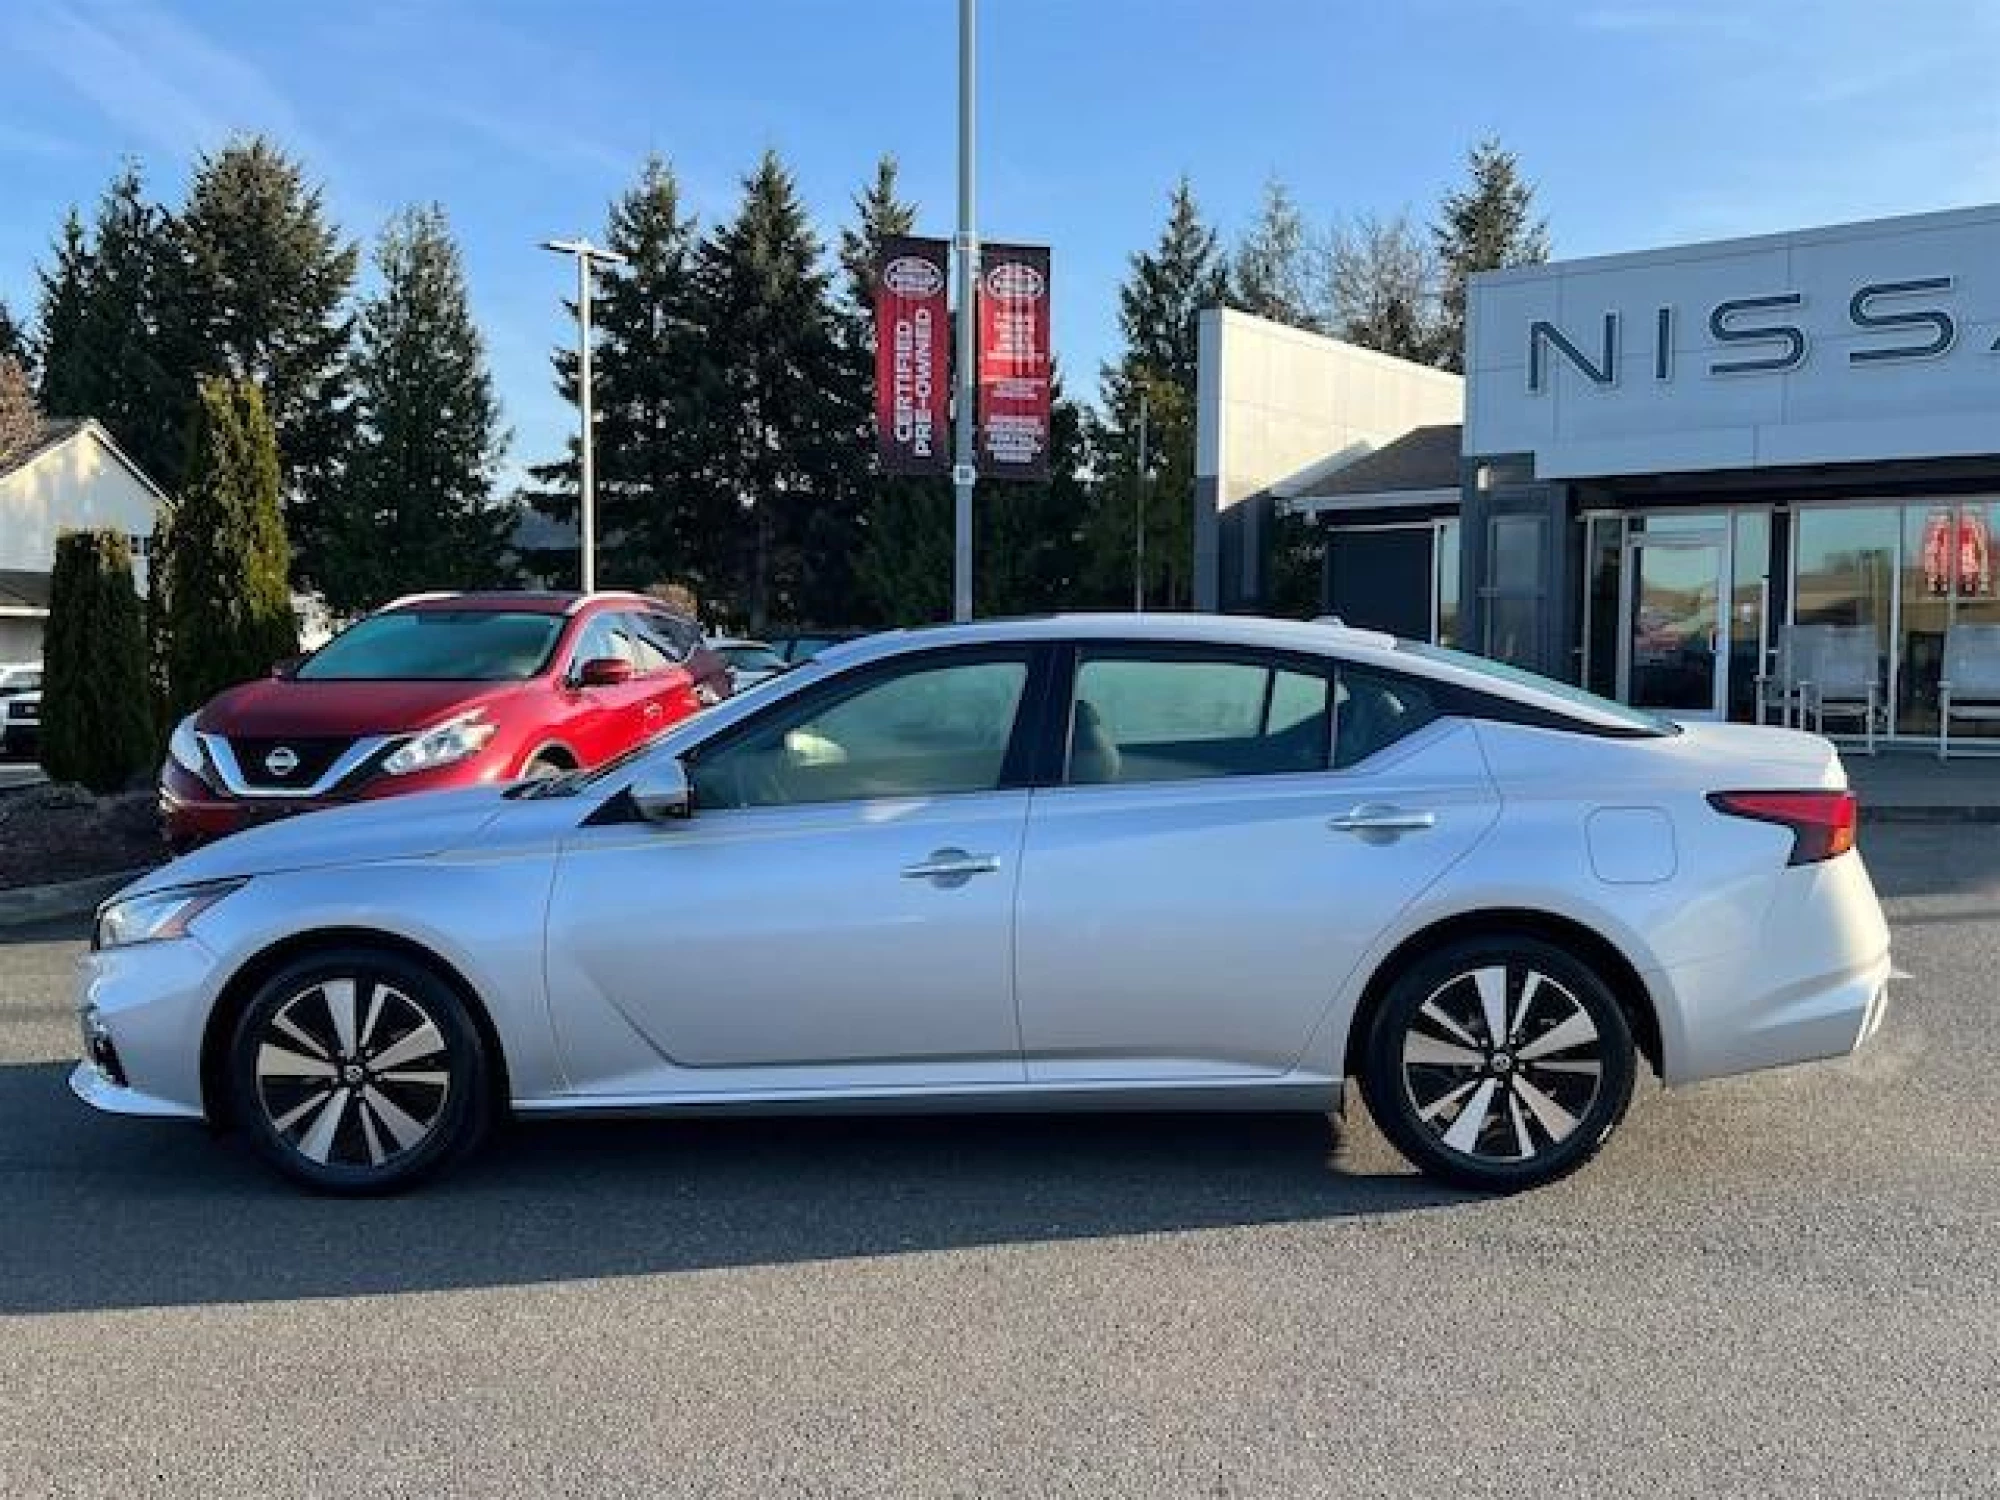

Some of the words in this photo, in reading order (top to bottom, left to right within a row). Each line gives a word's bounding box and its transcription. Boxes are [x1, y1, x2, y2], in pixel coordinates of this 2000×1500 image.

[894, 318, 913, 441] CERTIFIED
[914, 307, 932, 456] PRE-OWNED
[1530, 277, 2000, 390] NISS
